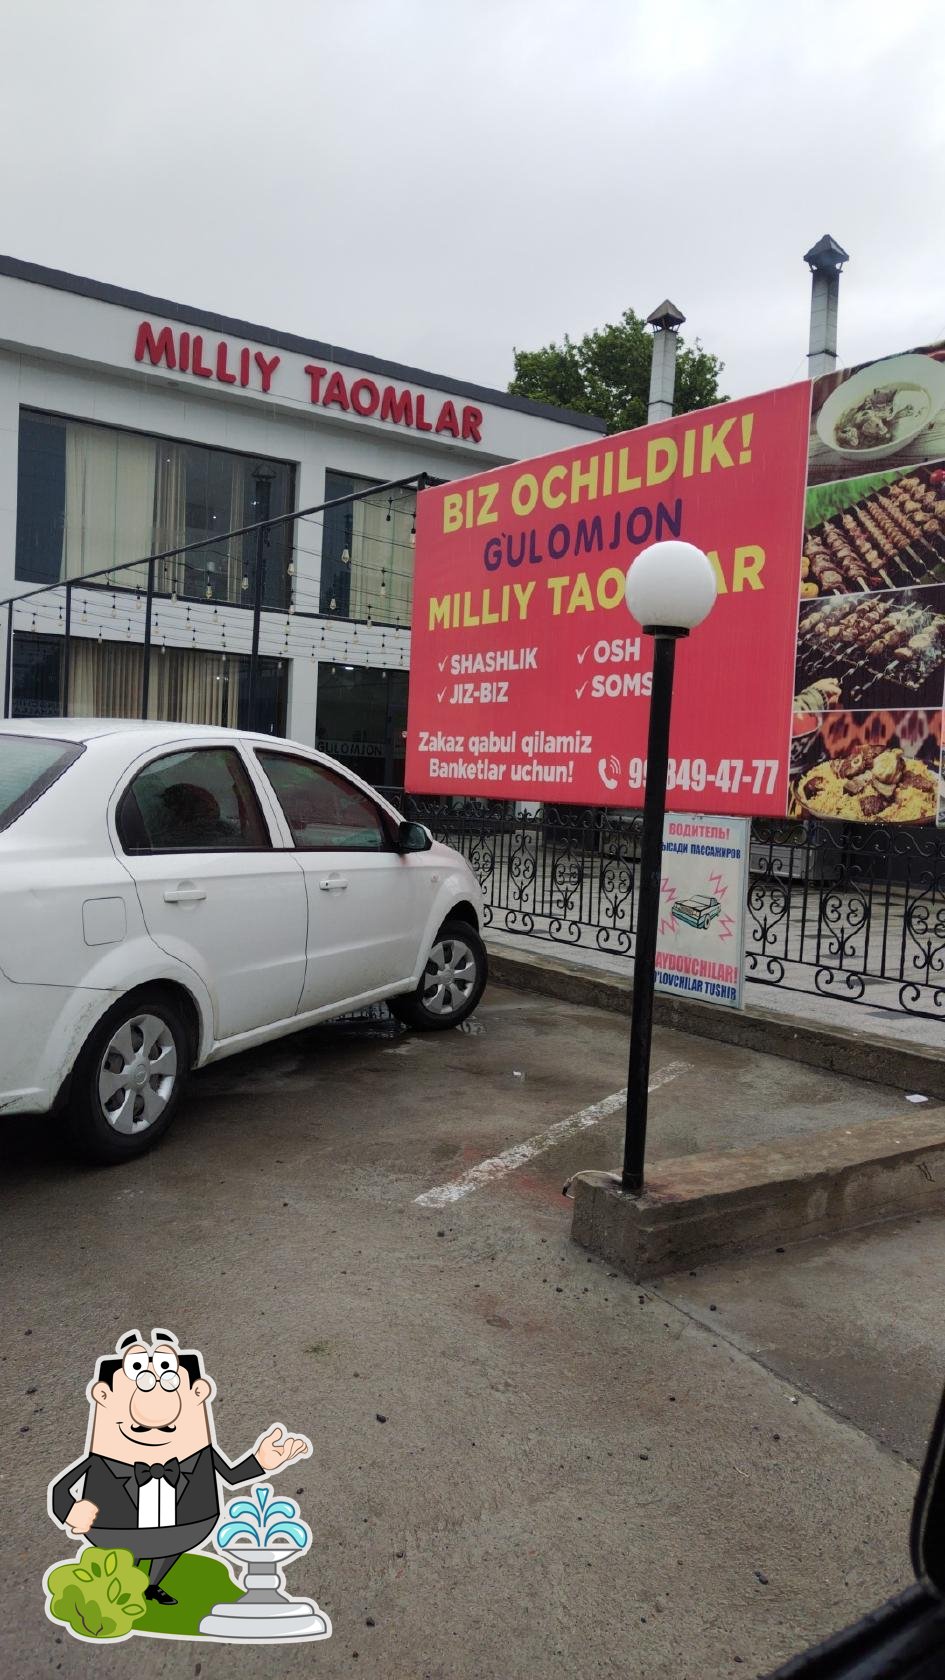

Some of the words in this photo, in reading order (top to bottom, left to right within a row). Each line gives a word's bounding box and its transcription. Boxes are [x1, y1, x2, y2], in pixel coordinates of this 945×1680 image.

[135, 321, 280, 393] MILLIY
[304, 364, 483, 443] TAOMLAR
[443, 482, 499, 534] BIZ
[511, 412, 754, 516] OCHILDIK!
[428, 581, 536, 631] MILLIY
[548, 545, 766, 615] TAOAR
[451, 647, 538, 675] SHASHLIK
[593, 637, 641, 664] OSH
[449, 682, 509, 704] JIZ-BIZ
[591, 672, 654, 698] SOMS
[418, 731, 464, 752] Zakaz
[468, 731, 516, 756] qabul
[521, 730, 592, 757] qilamiz
[429, 758, 506, 781] Banketlar
[511, 759, 574, 783] uchun!
[668, 823, 730, 840] ВОДИТЕЛЬ!
[690, 844, 741, 859] ПАССАЖИРОВ
[655, 951, 738, 984] AYDOVCHILAR!
[704, 982, 737, 1001] TUSHIR
